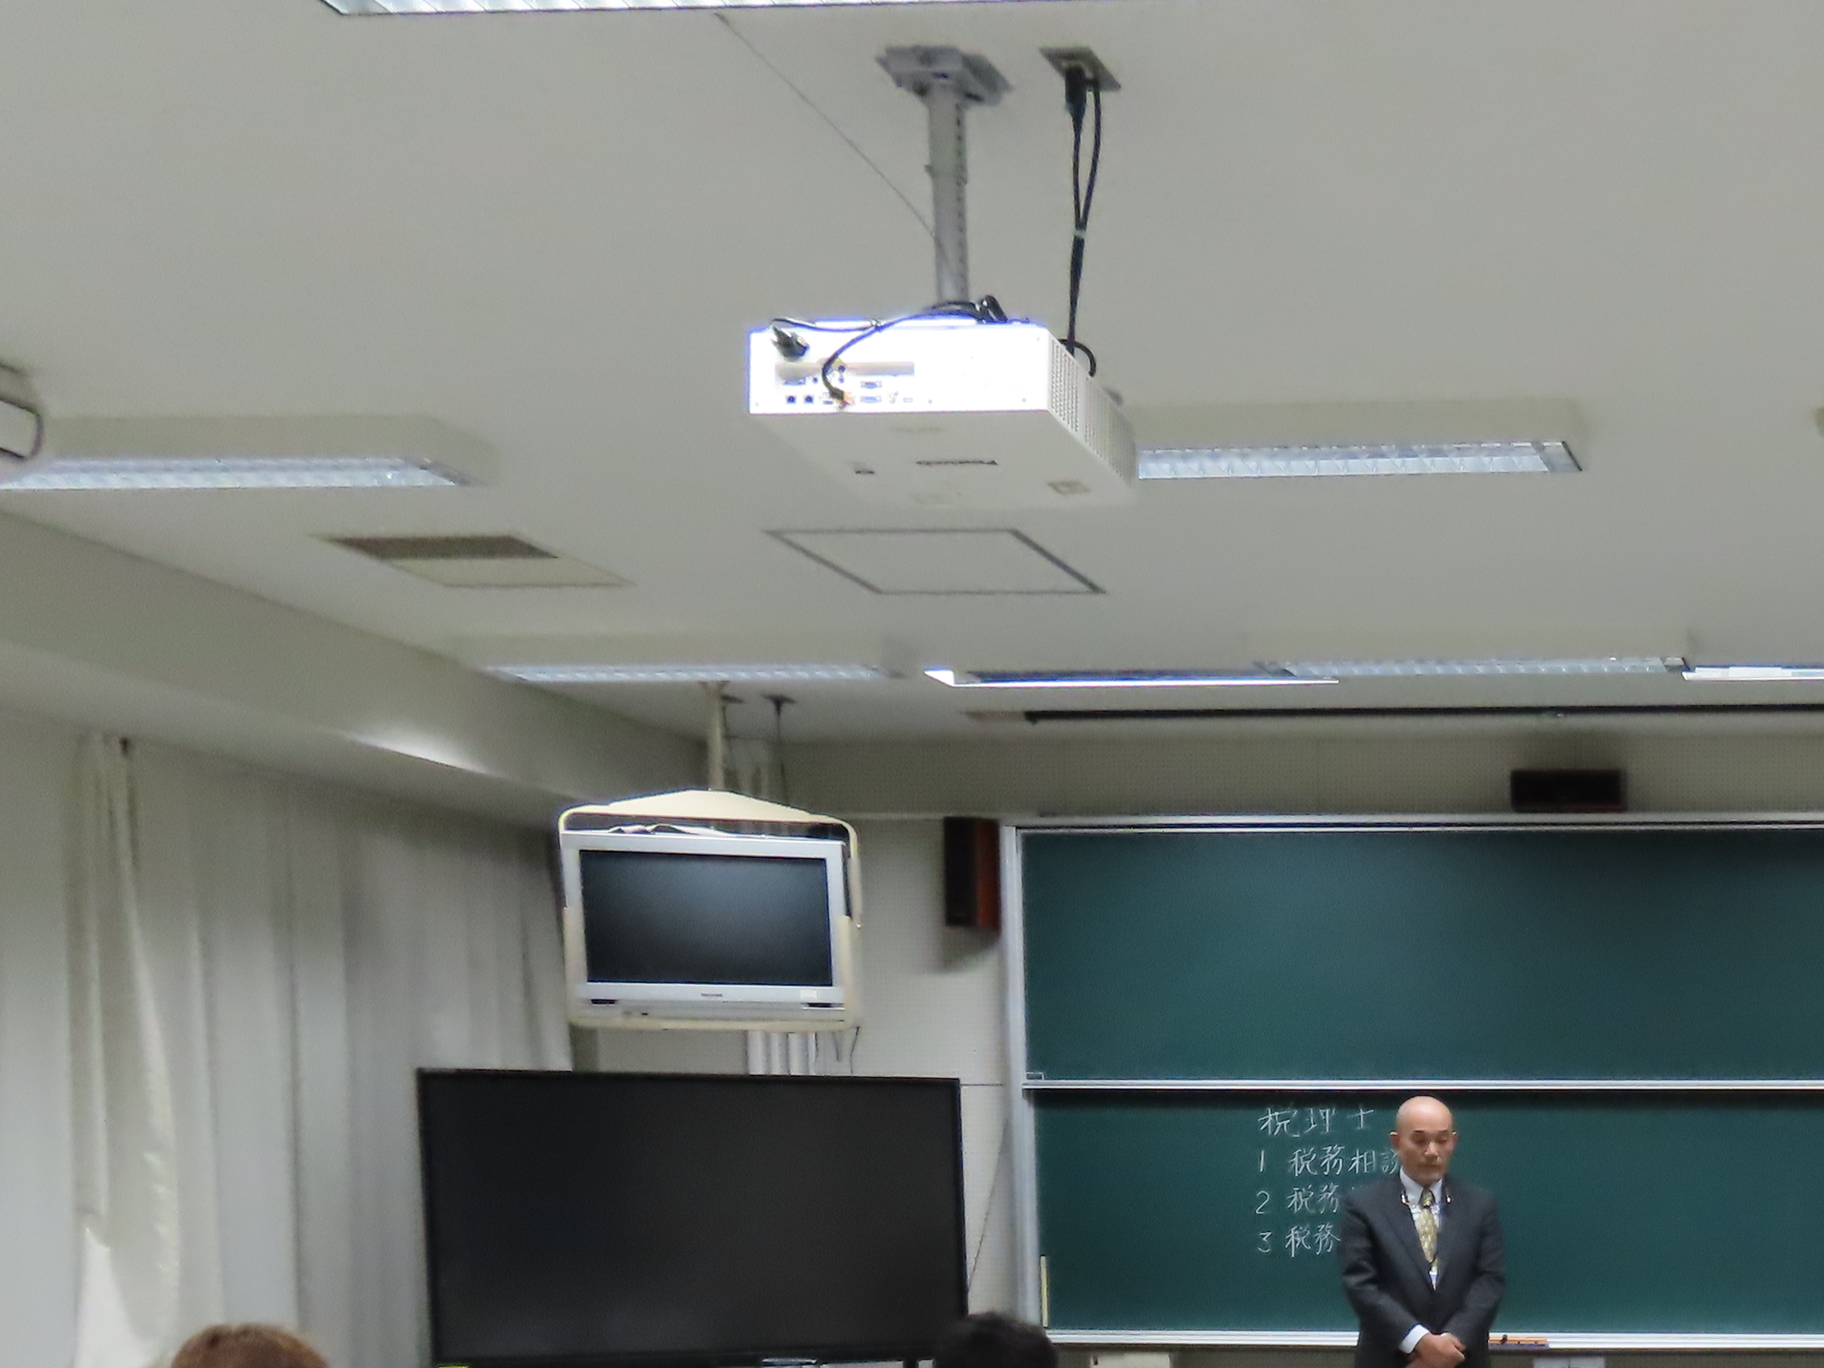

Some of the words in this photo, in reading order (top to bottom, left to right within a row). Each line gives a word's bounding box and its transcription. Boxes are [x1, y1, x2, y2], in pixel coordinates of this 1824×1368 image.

[1257, 1104, 1375, 1137] 税理士
[1255, 1190, 1271, 1215] 2
[1257, 1231, 1273, 1253] 3
